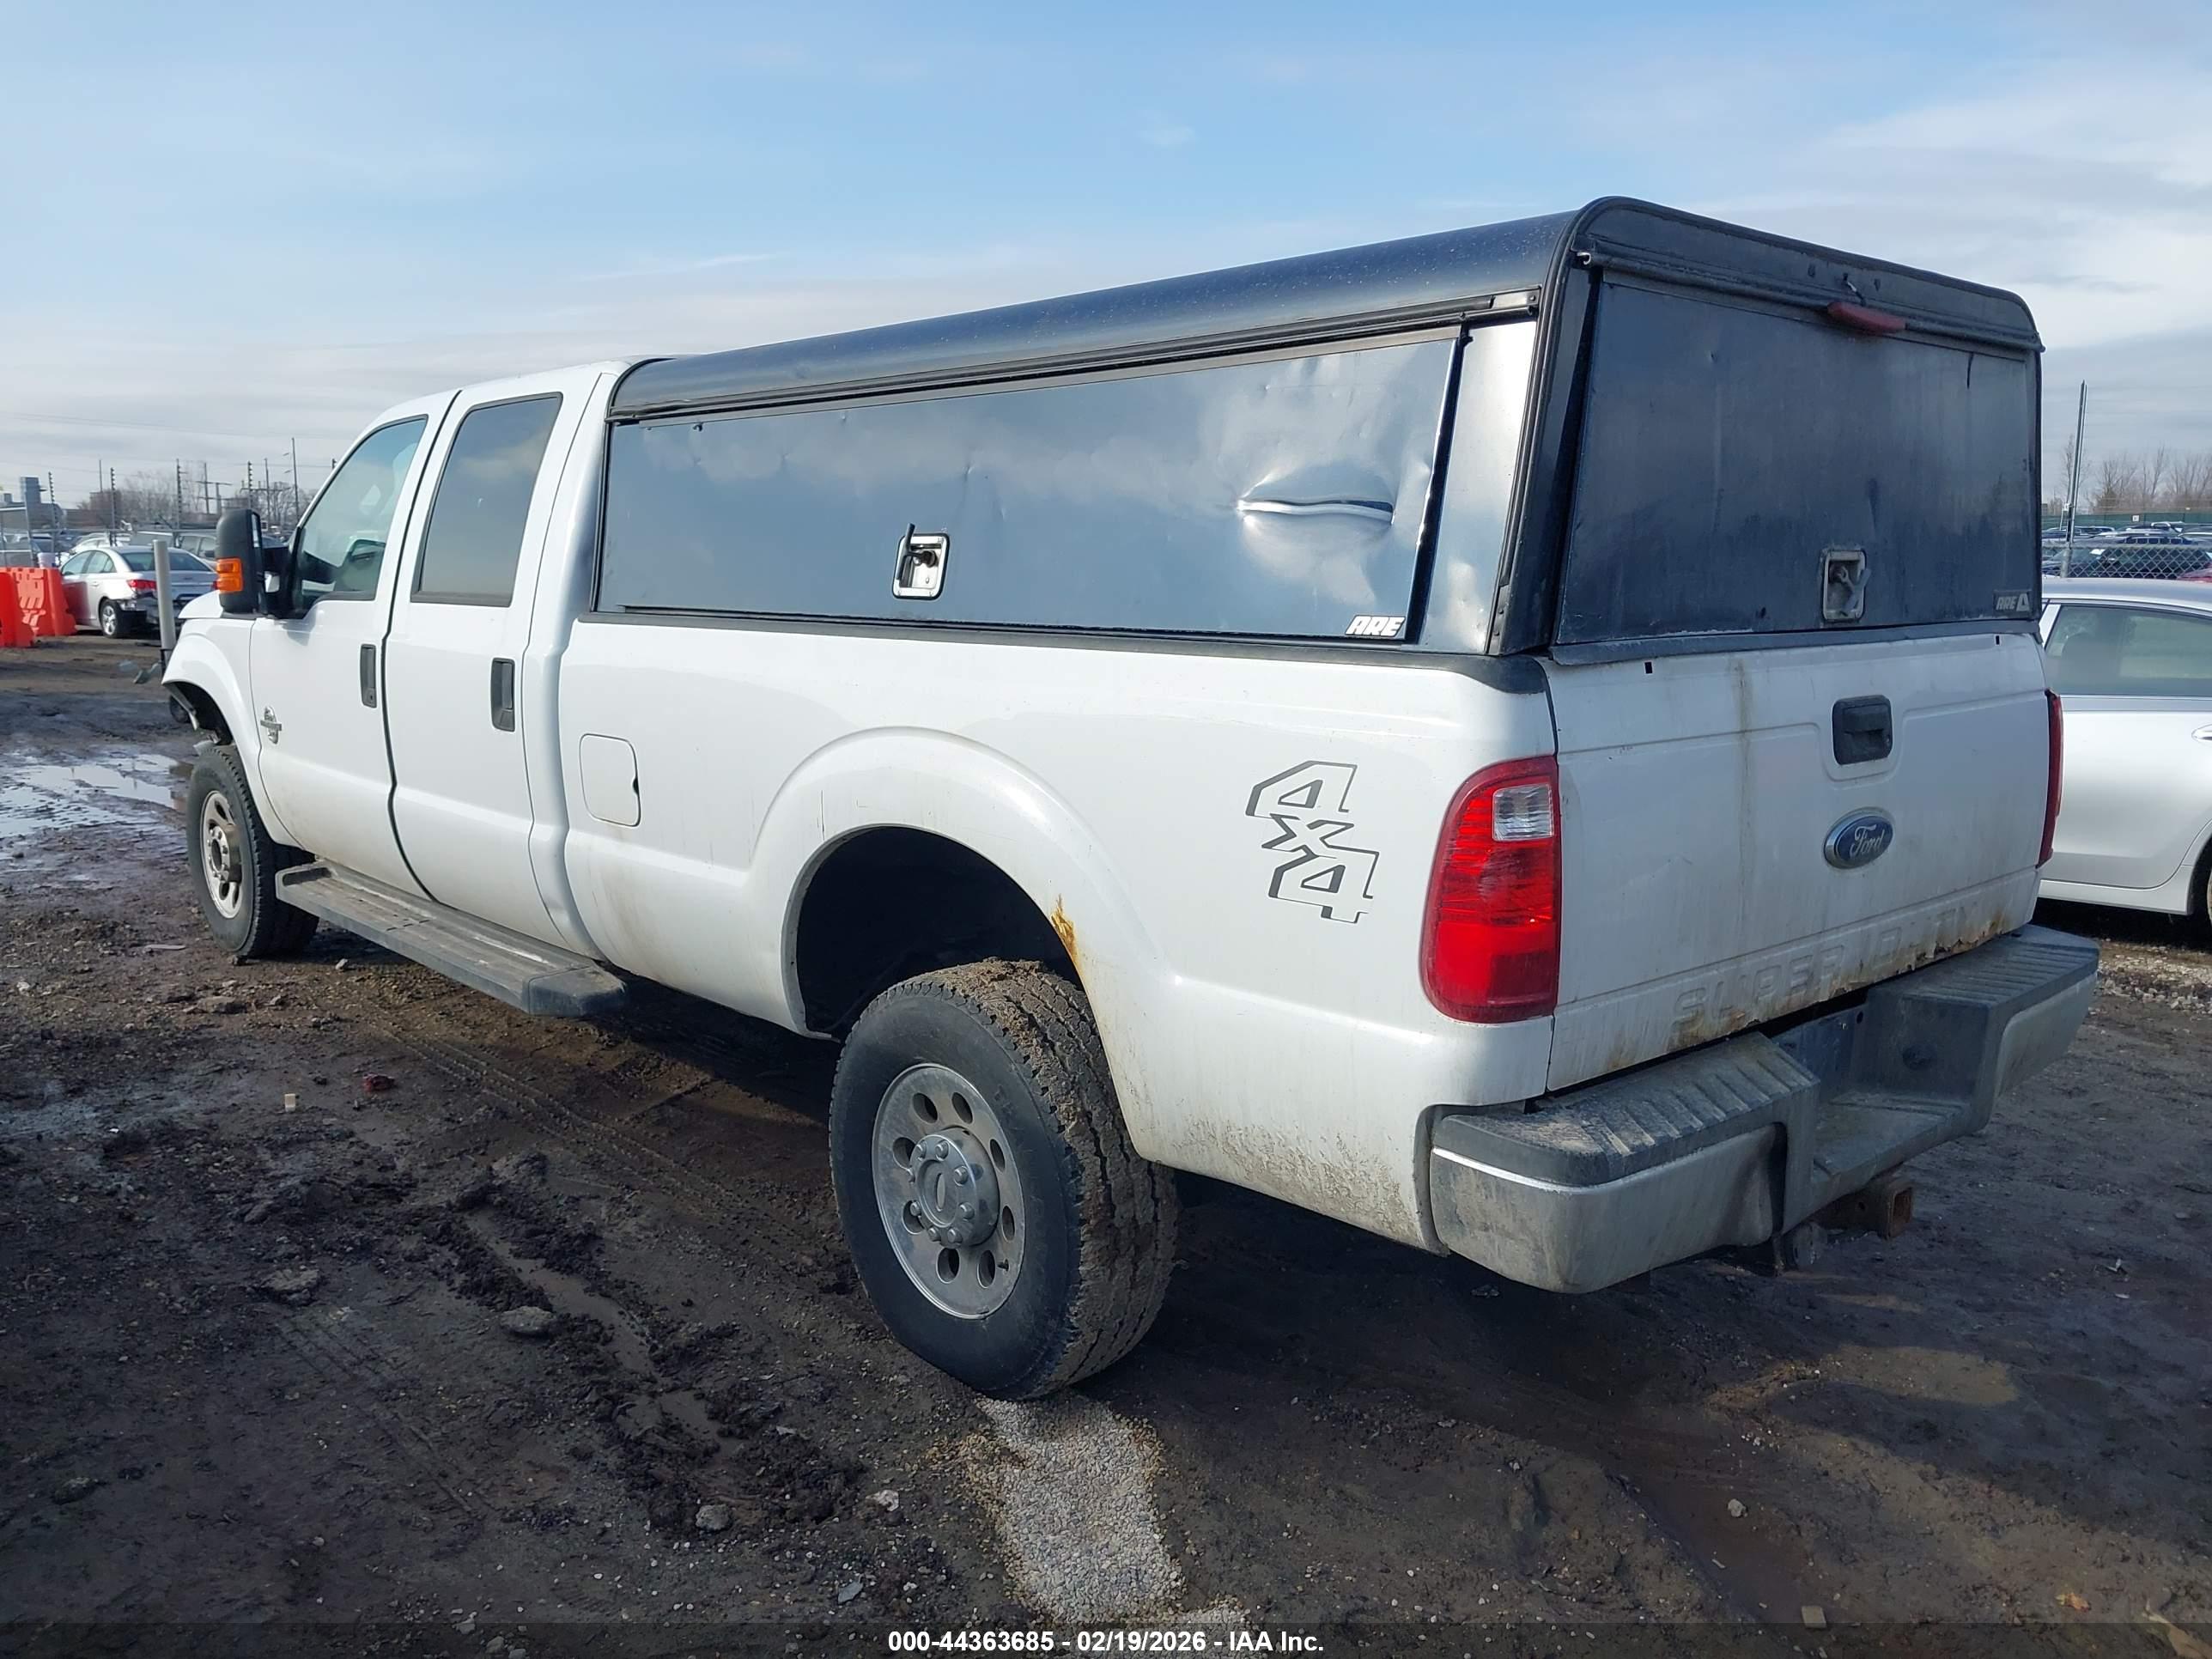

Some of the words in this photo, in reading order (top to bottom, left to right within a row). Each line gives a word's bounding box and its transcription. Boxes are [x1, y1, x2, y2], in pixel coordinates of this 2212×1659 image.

[1345, 616, 1407, 637] ARE
[1849, 823, 1887, 859] Ford
[1668, 944, 1844, 1036] SUPER
